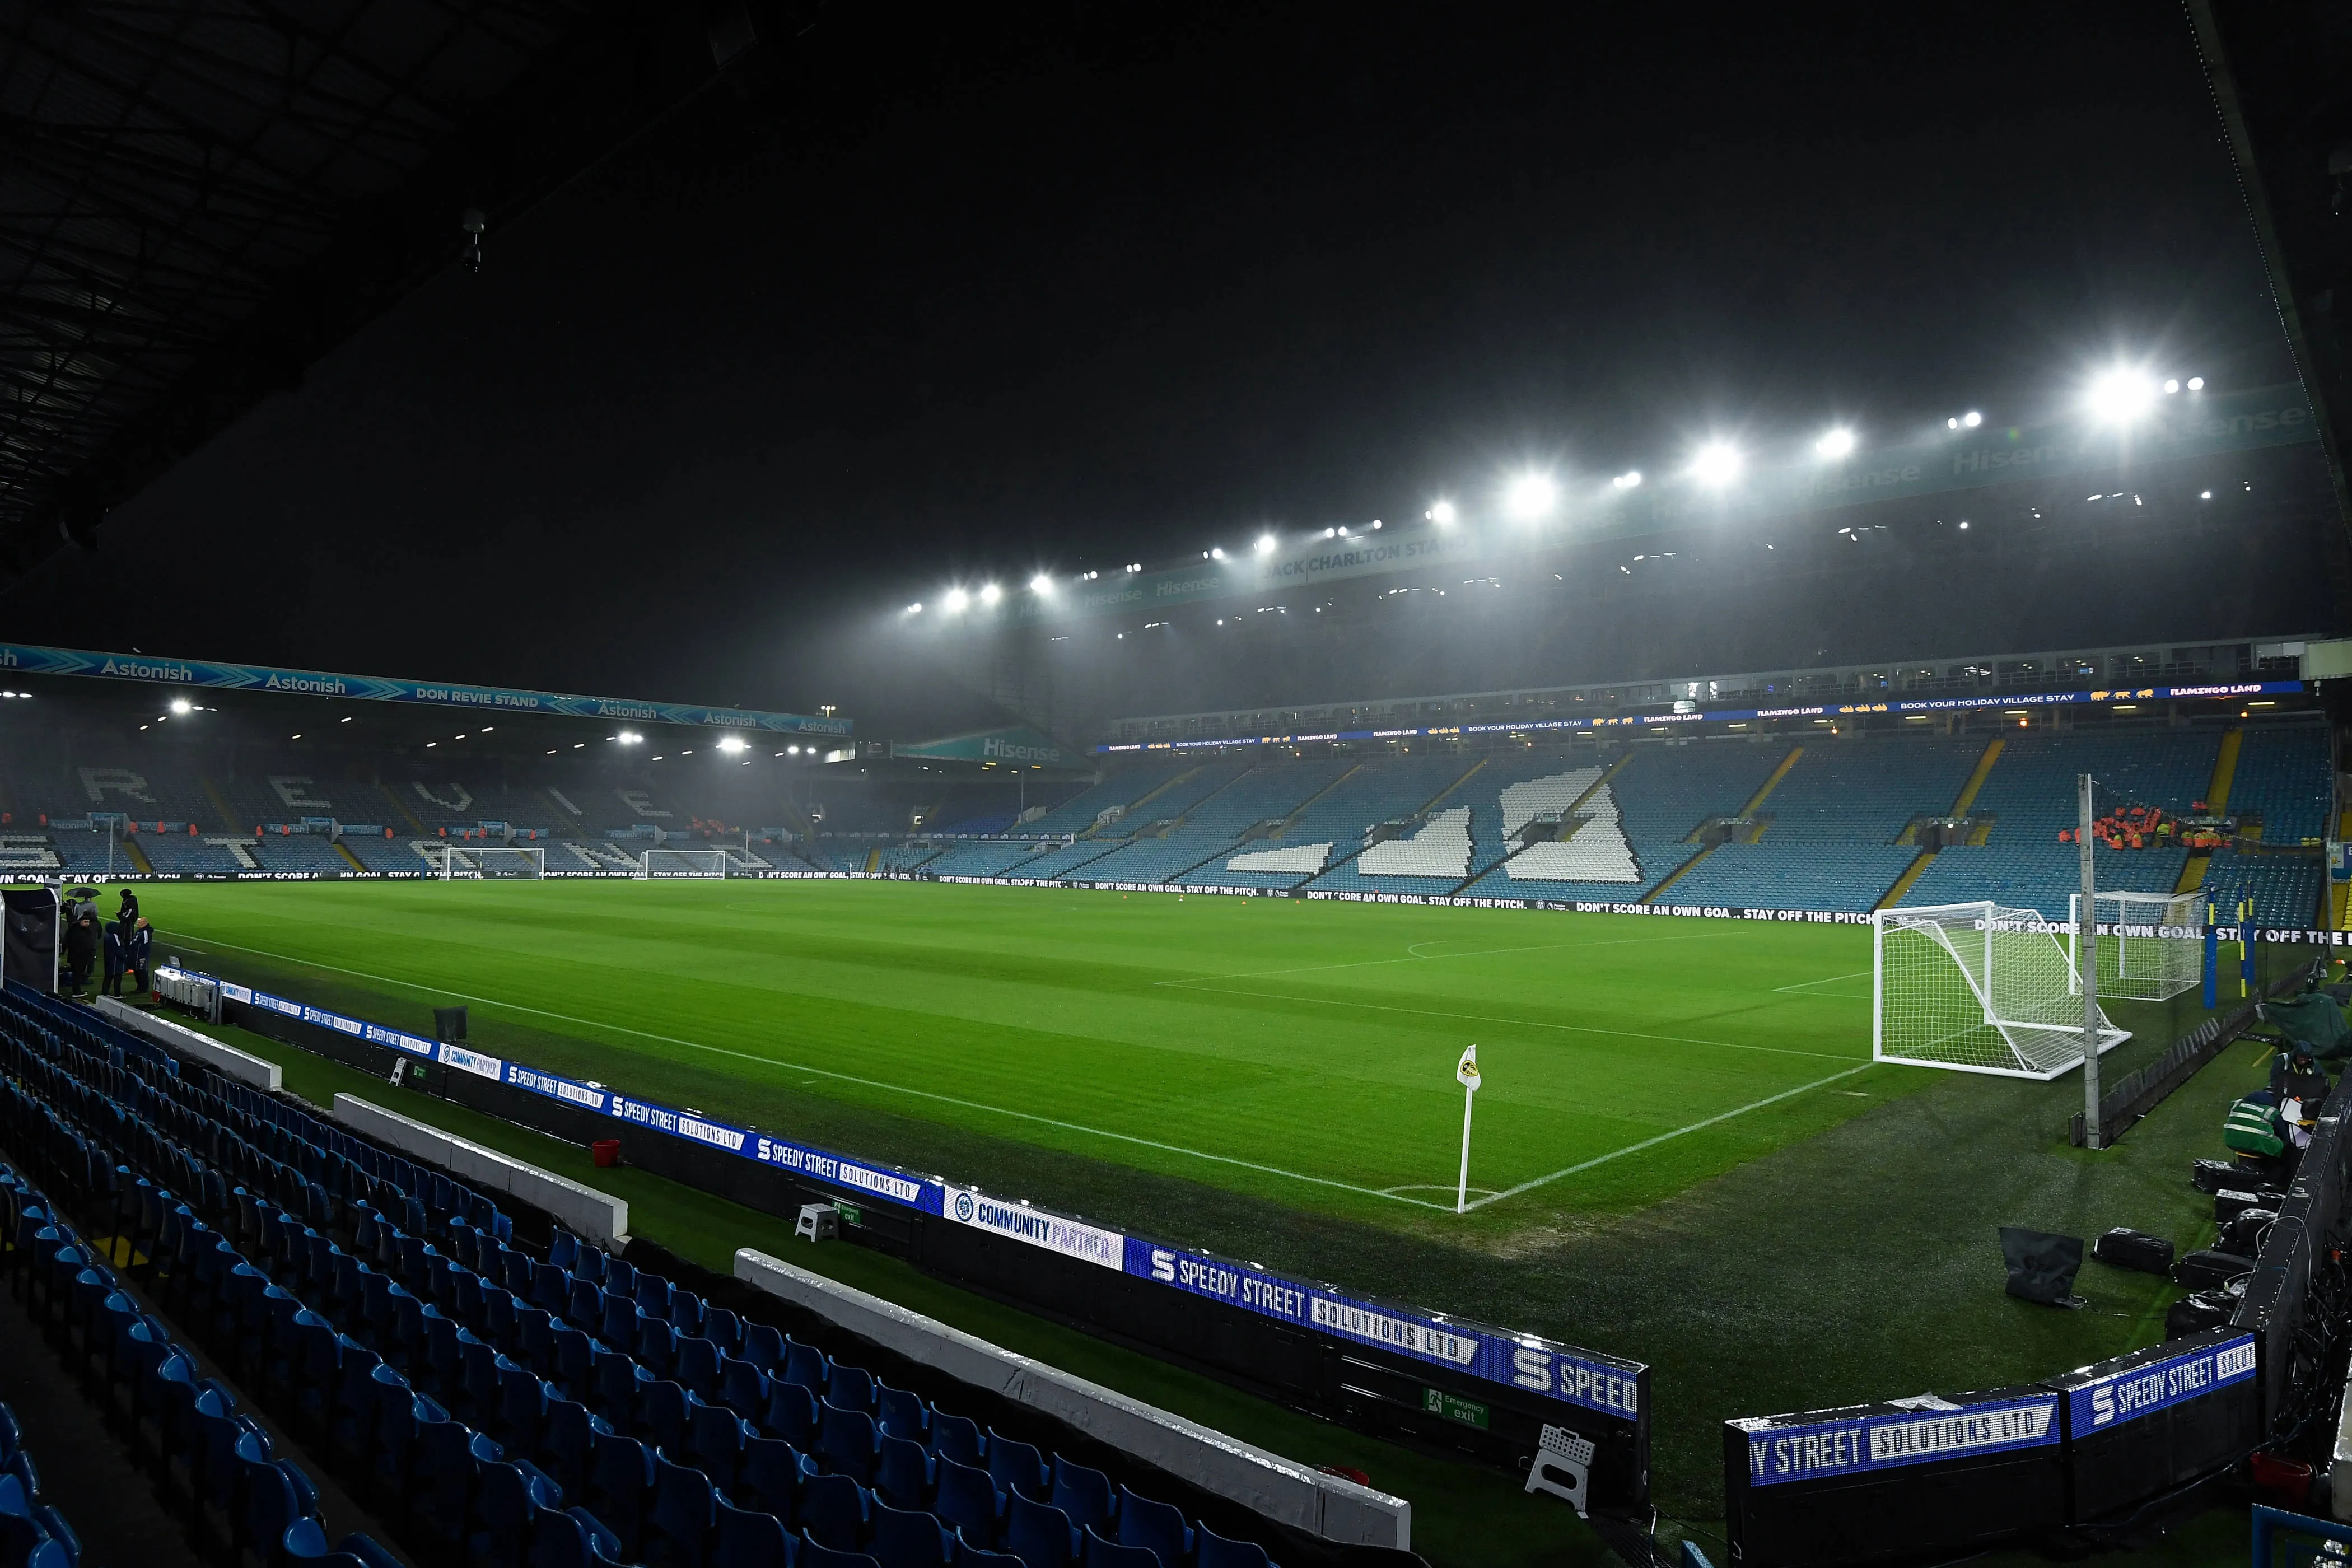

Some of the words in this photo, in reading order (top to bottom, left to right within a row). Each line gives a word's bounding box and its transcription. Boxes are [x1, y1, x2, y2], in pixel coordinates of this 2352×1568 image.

[1308, 544, 1401, 571] CHARLTON
[1156, 576, 1219, 598] Hisense
[101, 657, 192, 681] Astonish
[265, 672, 346, 694] Astonish
[2169, 686, 2228, 696] FLAMINGO
[2230, 684, 2261, 693] LAND
[416, 688, 448, 701] DON
[452, 690, 491, 704] REVIE
[495, 694, 539, 708] STAND
[1958, 698, 2000, 707] HOLIDAY
[2002, 696, 2043, 704] VILLAGE
[597, 702, 657, 719] Astonish
[704, 711, 756, 727] Astonish
[799, 720, 846, 734] Astonish
[983, 738, 1060, 762] Hisense
[59, 874, 90, 884] SAY
[1095, 882, 1114, 890] DON'T
[1116, 883, 1136, 891] SCORE
[1137, 883, 1146, 892] AN
[1148, 884, 1164, 892] OWN
[1165, 884, 1185, 893] GOAL,
[1187, 885, 1203, 893] STAY
[1205, 885, 1218, 894] OFF
[1220, 886, 1233, 895] THE
[1235, 887, 1259, 897] PITCH.
[1307, 891, 1332, 899] DON'T
[1363, 893, 1375, 902] AN
[1379, 894, 1398, 903] OWN
[1429, 896, 1451, 906] STAY
[1453, 897, 1471, 907] OFF
[1473, 898, 1492, 908] THE
[1494, 899, 1527, 909] PITCH.
[1576, 902, 1611, 913] DON'T
[1613, 904, 1650, 914] SCORE
[1653, 906, 1669, 916] AN
[1672, 906, 1701, 917] OWN
[1743, 909, 1774, 920] STAY
[1777, 911, 1803, 921] OFF
[1806, 912, 1831, 923] THE
[2027, 921, 2080, 934] SCORE
[2113, 925, 2153, 937] OWN
[2215, 927, 2260, 941] STY
[2265, 930, 2301, 943] OFF
[2306, 931, 2342, 945] THE
[372, 1028, 386, 1044] SPEEDY
[386, 1031, 400, 1046] STREET
[451, 1049, 477, 1070] COMMUNITY
[477, 1055, 496, 1076] PARTNER
[517, 1070, 538, 1089] SPEEDY
[537, 1076, 557, 1094] STREET
[560, 1084, 588, 1103] SOLUTIONS
[624, 1101, 650, 1126] SPEEDY
[651, 1109, 677, 1132] STREET
[682, 1120, 720, 1142] SOLUTIONS
[724, 1131, 739, 1149] LTD.
[772, 1144, 804, 1168] SPEEDY
[805, 1153, 838, 1178] STREET
[843, 1167, 890, 1191] SOLUTIONS
[894, 1180, 914, 1200] LTD.
[978, 1203, 1050, 1242] COMMUNITY
[1052, 1224, 1109, 1259] PARTNER
[1180, 1259, 1239, 1298] SPEEDY
[1243, 1277, 1304, 1318] STREET
[1318, 1302, 1416, 1347] SOLUTIONS
[1561, 1363, 1637, 1413] SPEED
[2118, 1371, 2165, 1414] SPEEDY
[2169, 1356, 2214, 1396] STREET
[1445, 1394, 1484, 1414] Emergency
[1454, 1408, 1475, 1423] exit
[1775, 1427, 1863, 1474] STREET
[1881, 1417, 1990, 1455] SOLUTIONS
[2001, 1411, 2042, 1438] LTD.
